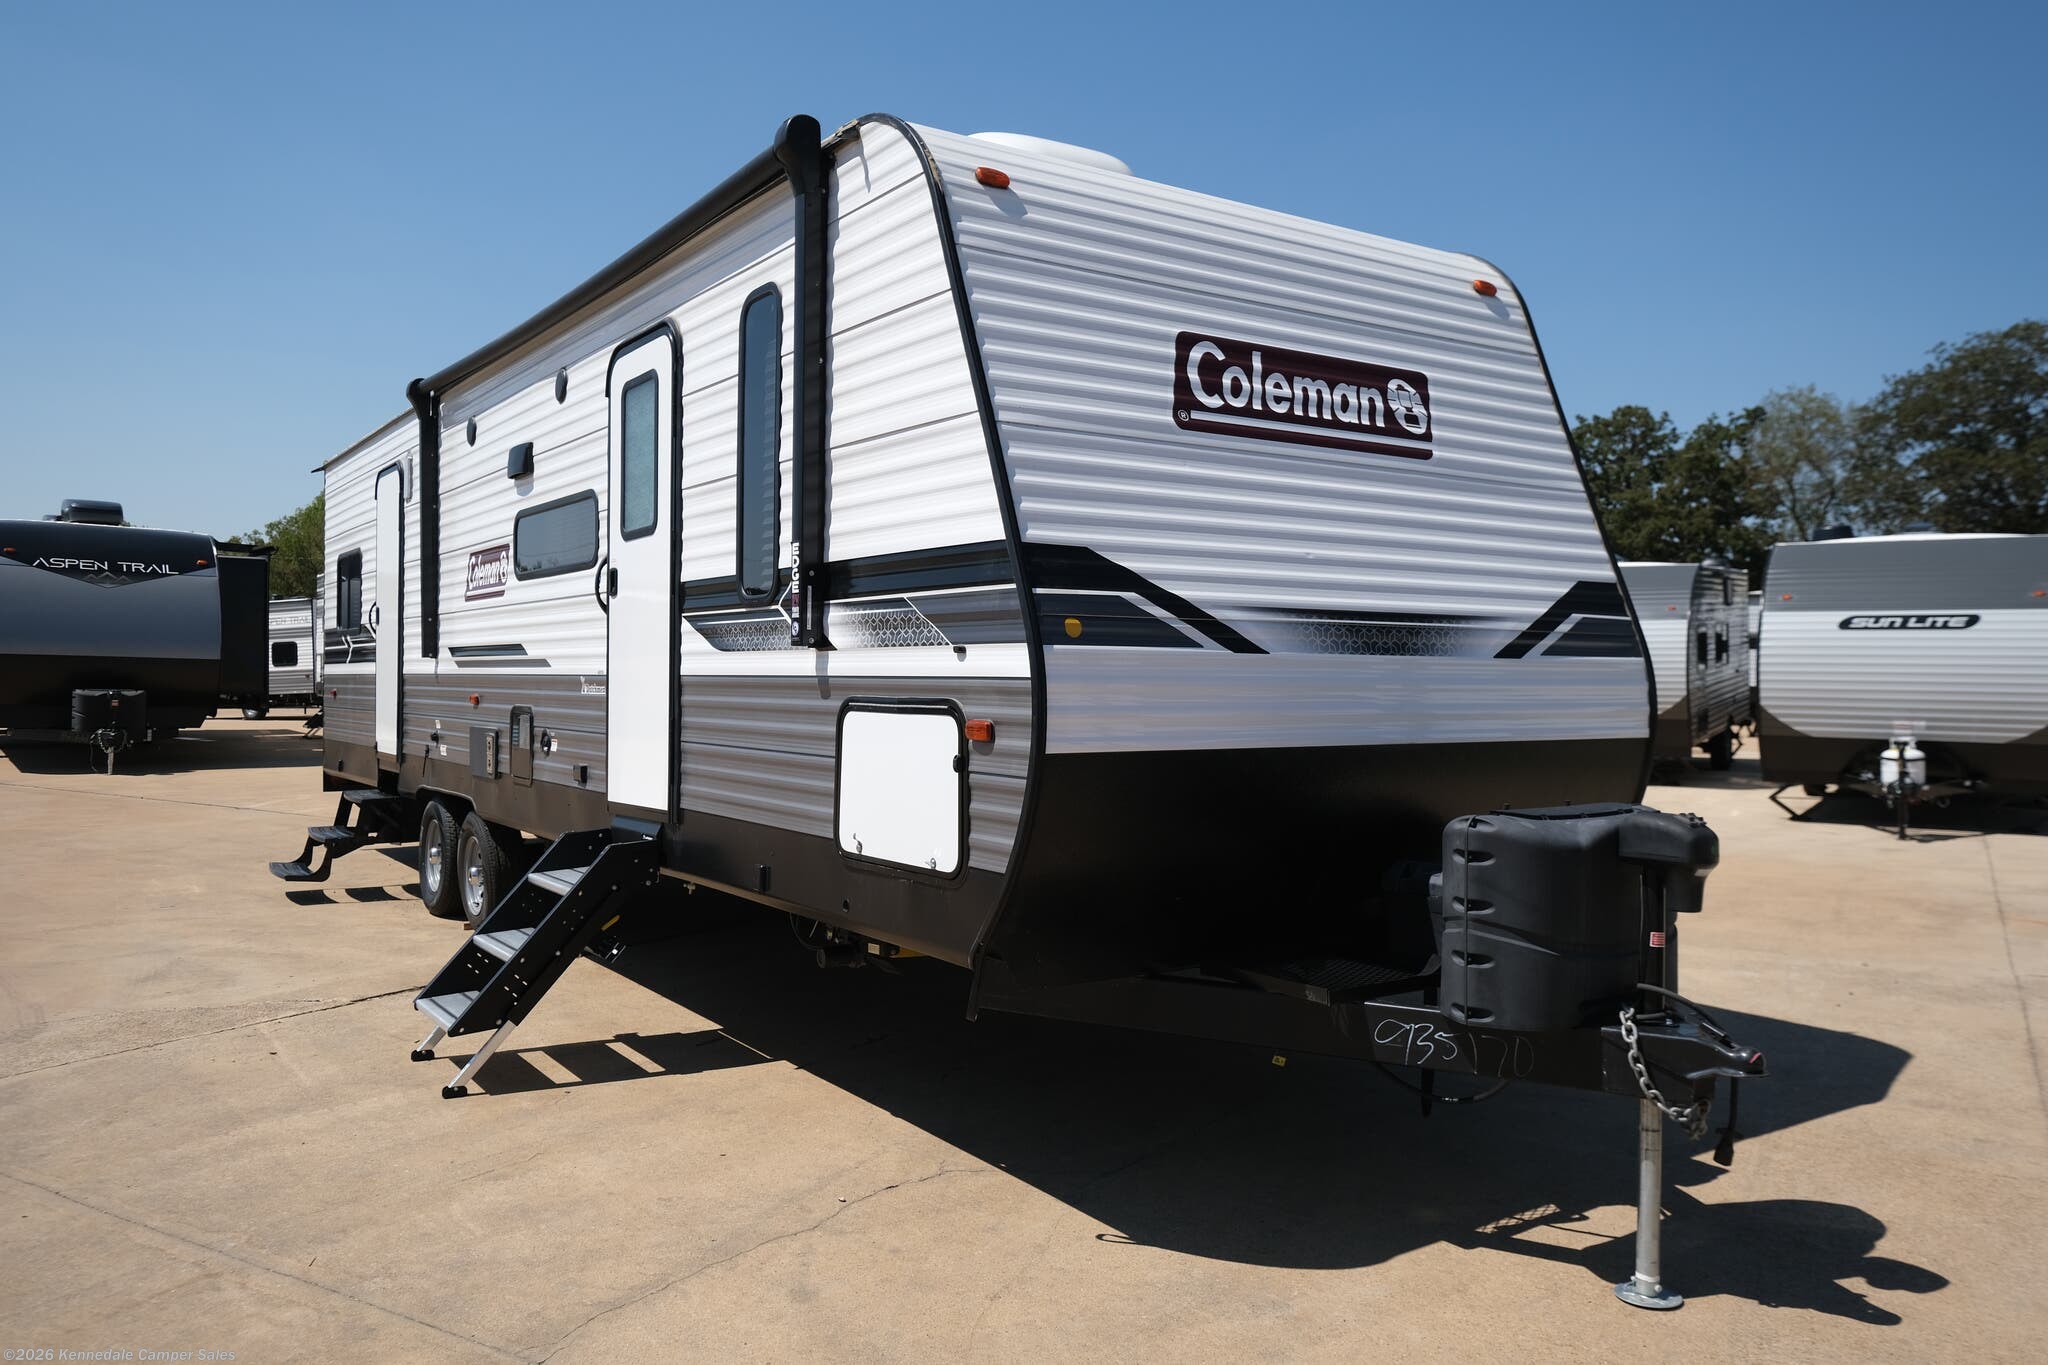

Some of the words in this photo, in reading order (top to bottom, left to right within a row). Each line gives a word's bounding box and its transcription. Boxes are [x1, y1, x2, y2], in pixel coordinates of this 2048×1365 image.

[1186, 340, 1386, 428] Coleman
[32, 557, 109, 571] ASPEN
[117, 561, 180, 575] TRAIL
[469, 554, 500, 590] Coleman
[1847, 616, 1904, 628] SUN
[1905, 616, 1970, 628] LITE
